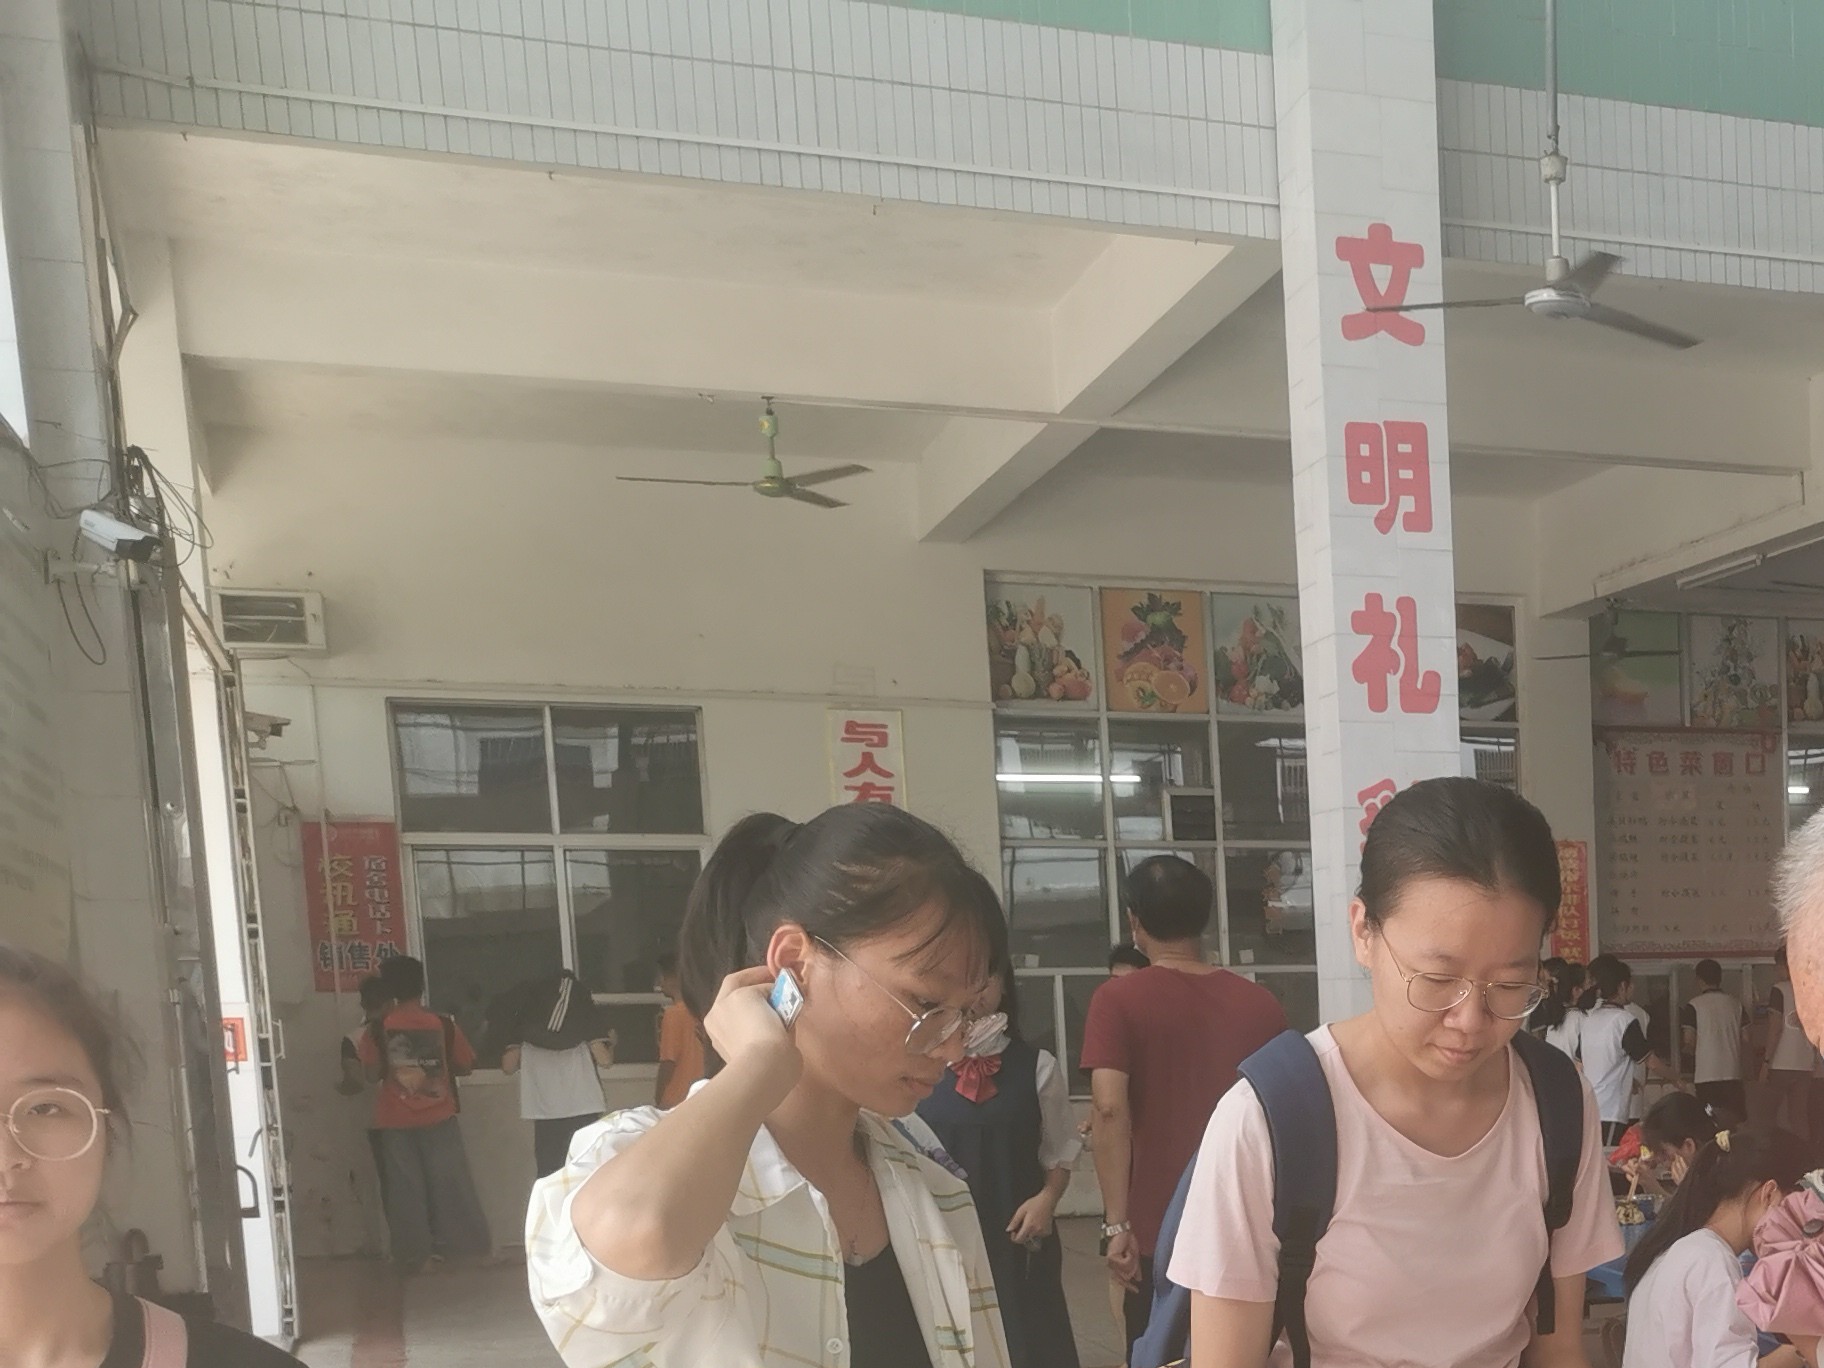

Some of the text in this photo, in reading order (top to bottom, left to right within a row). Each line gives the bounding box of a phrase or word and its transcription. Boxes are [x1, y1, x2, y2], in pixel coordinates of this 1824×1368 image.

[1336, 223, 1441, 854] 文明礼
[1613, 751, 1767, 777] 特色菜窗口
